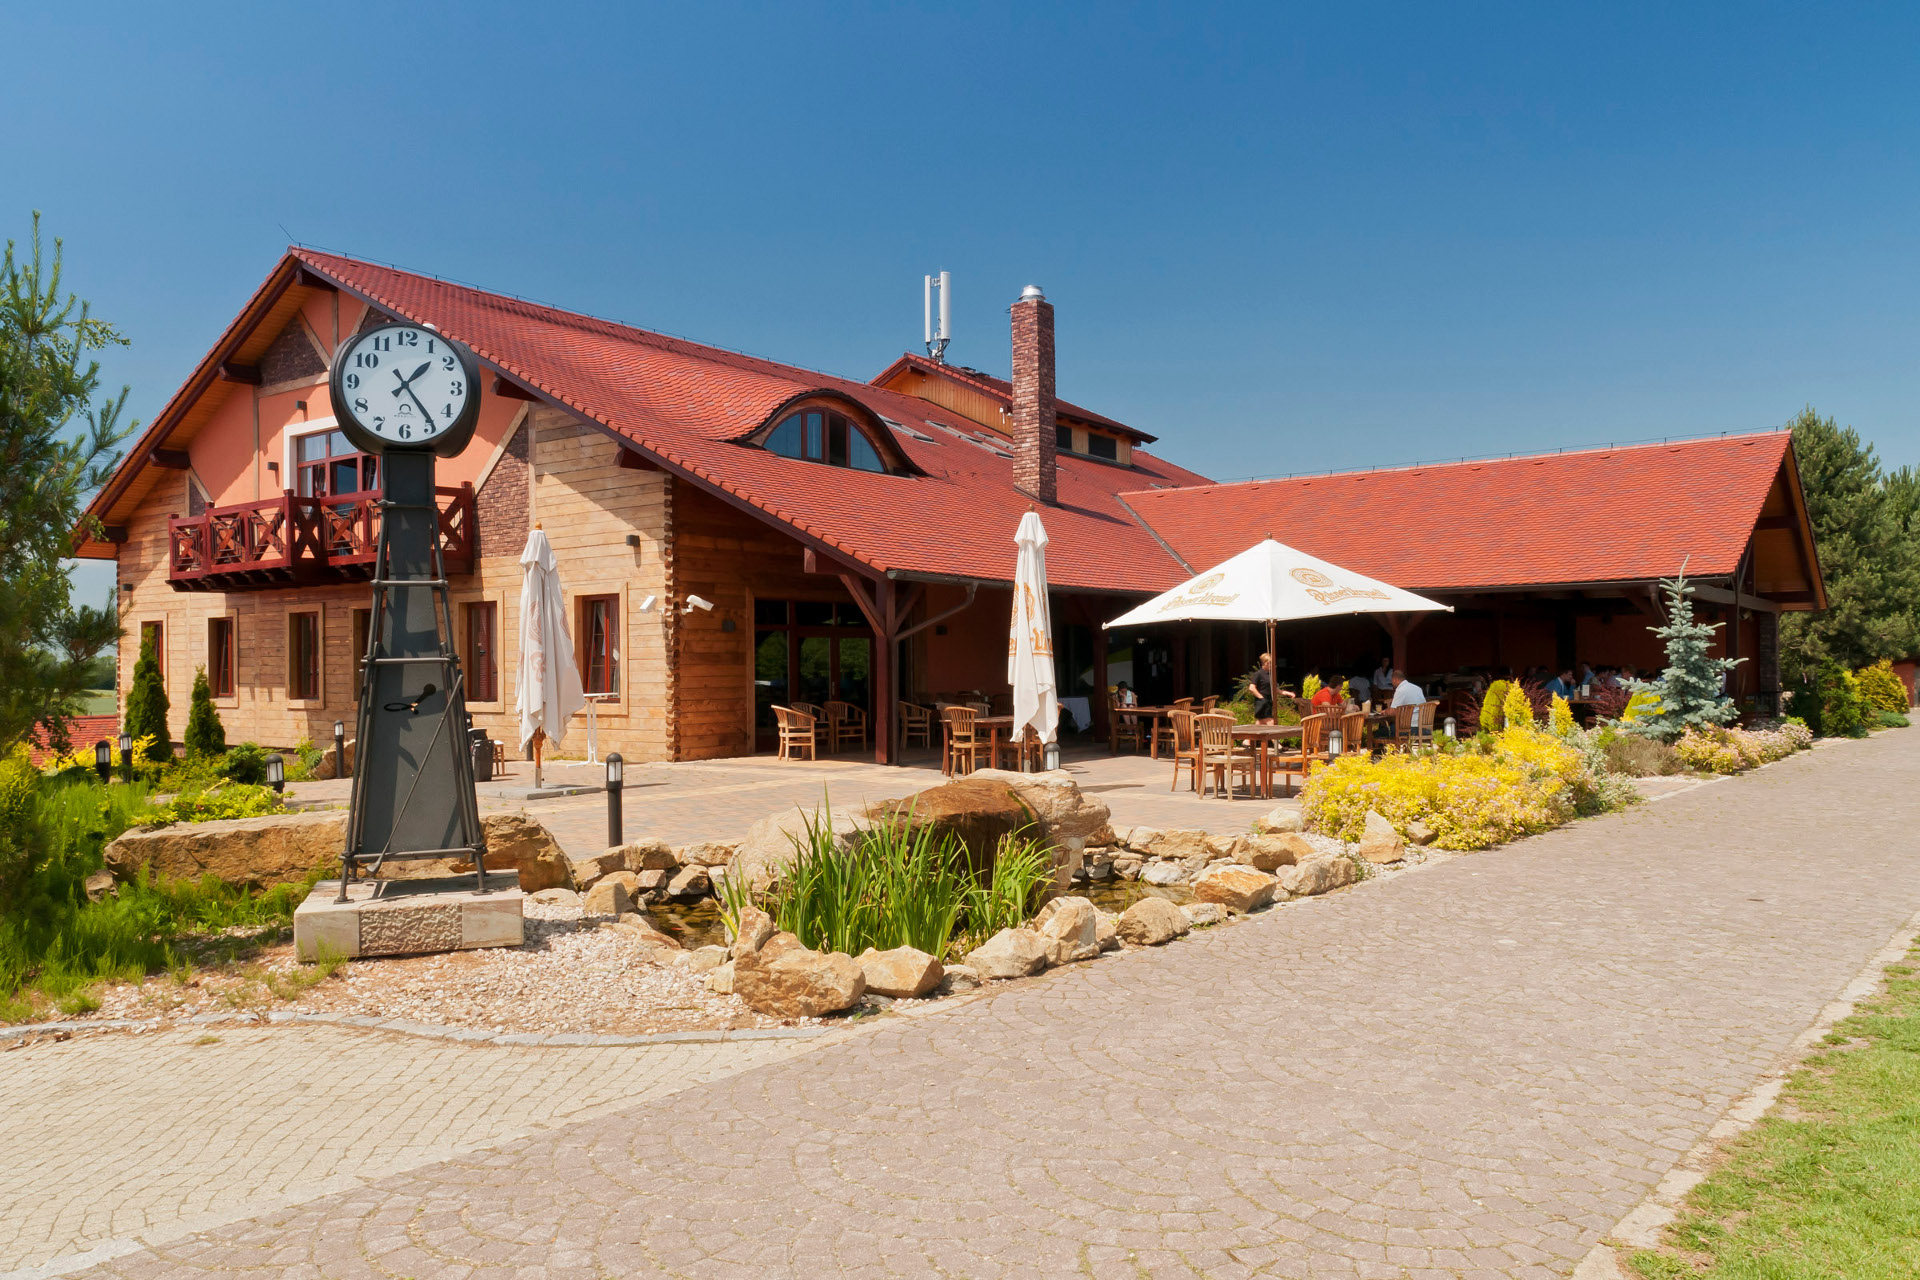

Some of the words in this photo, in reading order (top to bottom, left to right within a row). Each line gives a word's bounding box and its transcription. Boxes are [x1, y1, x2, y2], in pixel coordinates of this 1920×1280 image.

[373, 336, 390, 352] 11
[397, 331, 418, 347] 12
[426, 339, 436, 354] 1
[354, 352, 379, 368] 10
[442, 356, 455, 371] 2
[346, 373, 360, 389] 9
[450, 381, 463, 396] 3
[354, 397, 368, 413] 8
[440, 403, 453, 418] 4
[373, 416, 385, 432] 7
[398, 424, 411, 439] 6
[423, 418, 437, 434] 5
